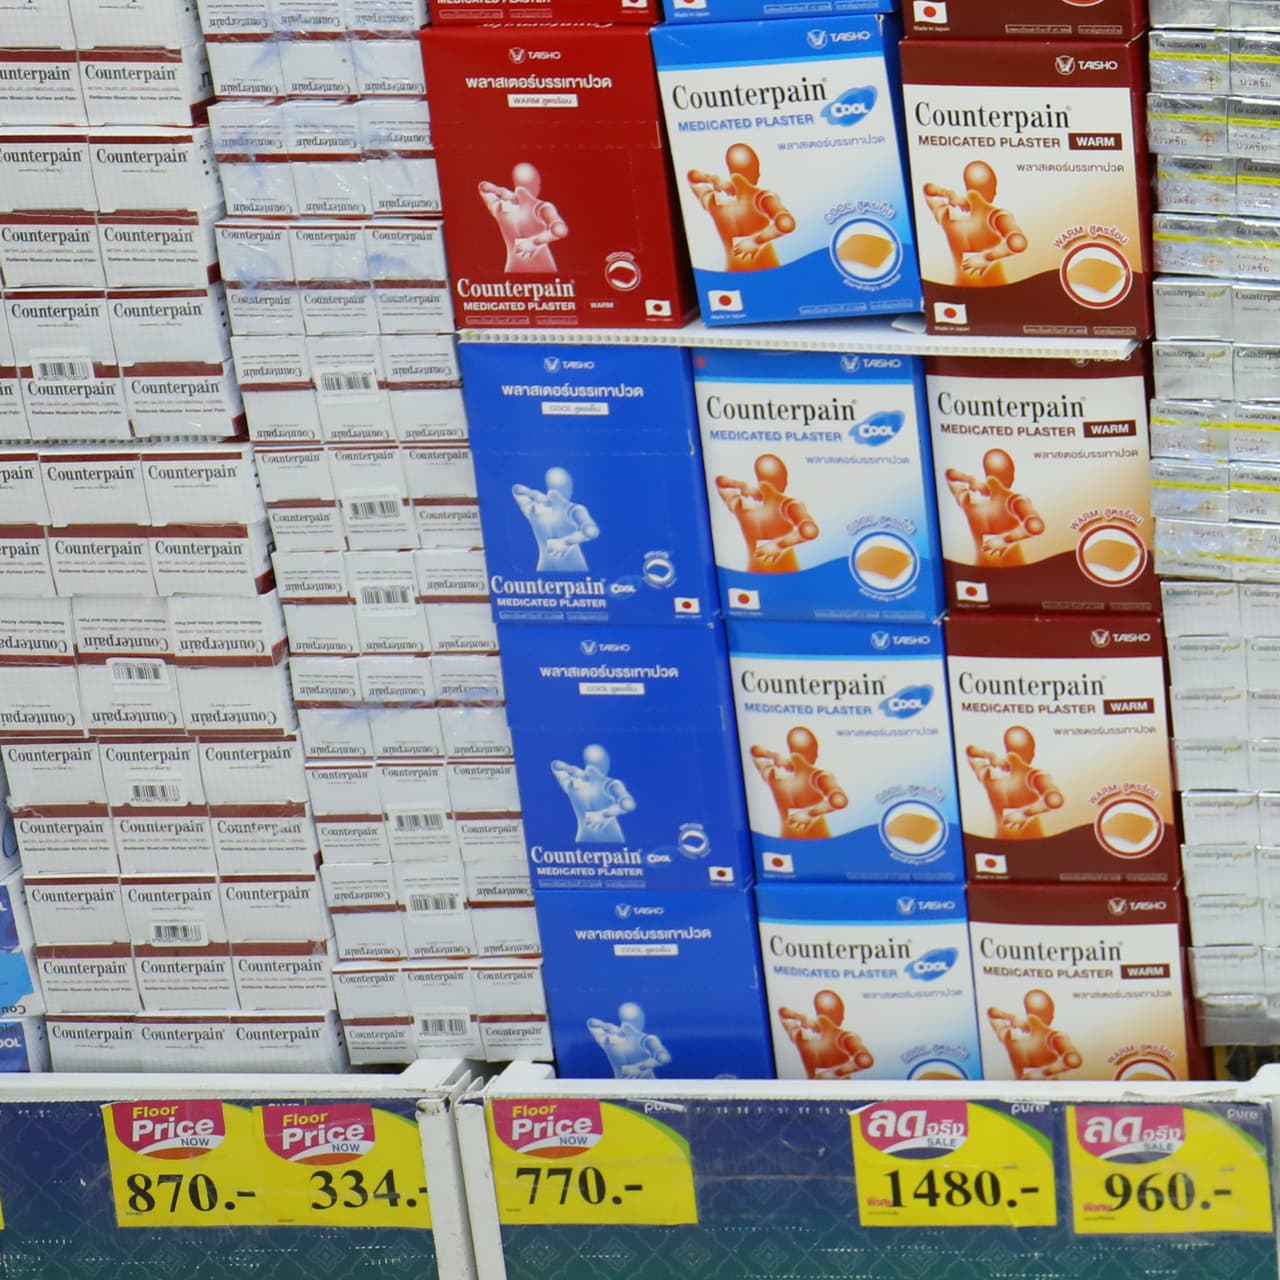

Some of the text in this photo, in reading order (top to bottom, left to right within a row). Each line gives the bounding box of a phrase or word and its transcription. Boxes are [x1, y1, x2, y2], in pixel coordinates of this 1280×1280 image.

[672, 78, 828, 111] Counterpain
[915, 102, 1070, 129] Counterpain
[104, 227, 194, 247] Counterpain
[296, 230, 357, 243] Counterpain
[937, 392, 1086, 419] Counterpain
[155, 540, 244, 558] Counterpain
[741, 668, 885, 698] Counterpain
[106, 747, 191, 764] Counterpain
[980, 938, 1122, 964] Counterpain
[236, 1026, 321, 1044] Counterpain
[133, 1103, 179, 1119] Floor
[867, 1107, 966, 1141] ลดจริง
[132, 1116, 215, 1143] Price
[511, 1115, 593, 1141] Price
[181, 1137, 210, 1147] NOW
[126, 1172, 256, 1214] 870.-
[310, 1169, 428, 1210] 334.-
[515, 1166, 644, 1206] 770.-
[886, 1169, 1040, 1210] 1480.-
[1106, 1172, 1232, 1212] 960.-
